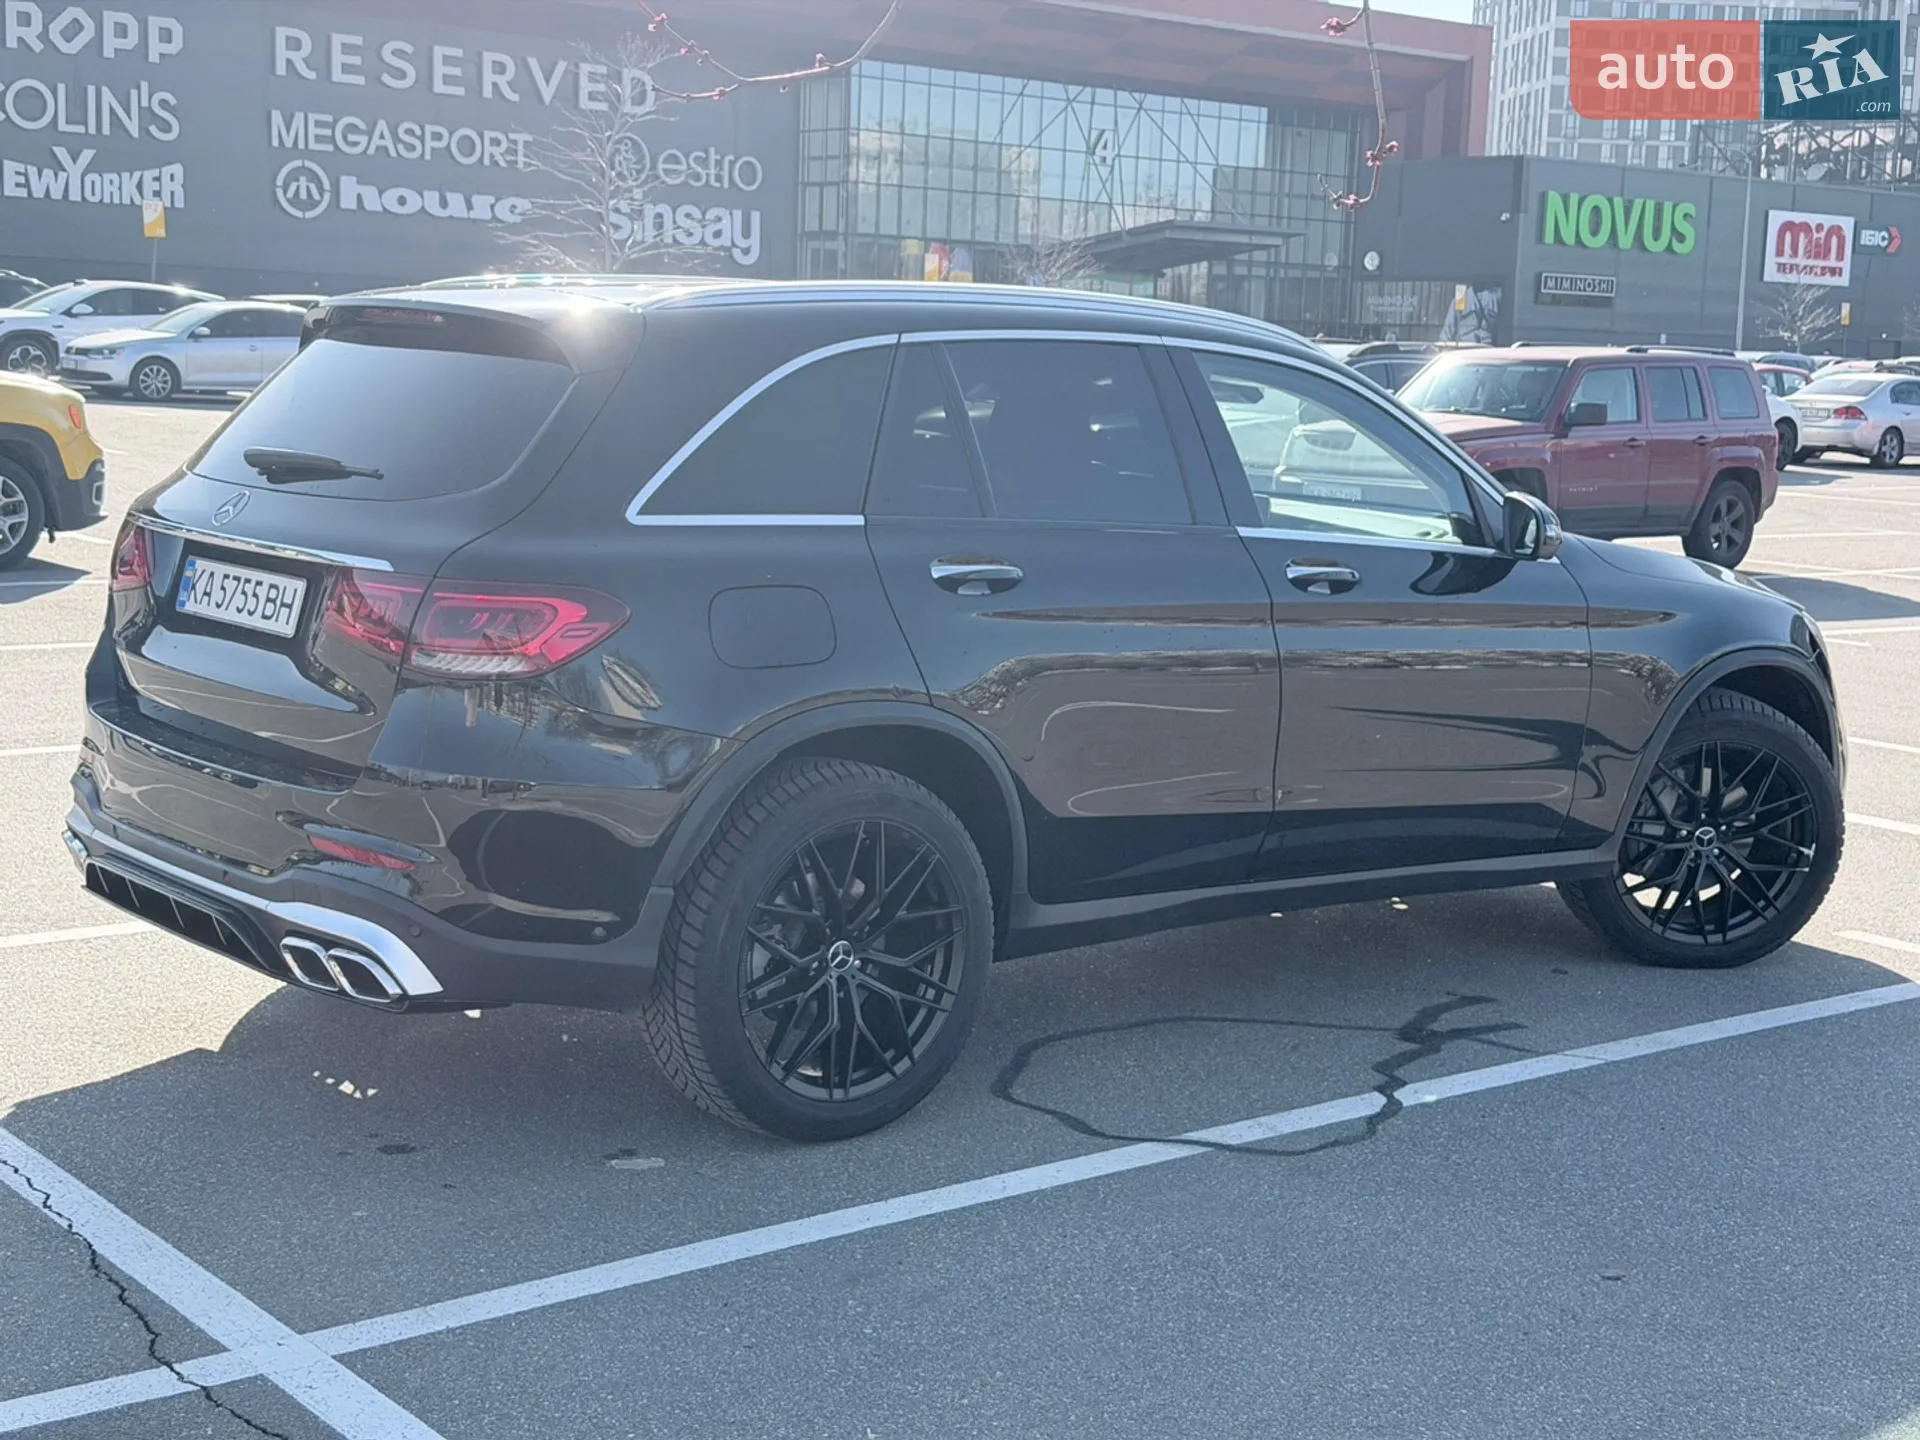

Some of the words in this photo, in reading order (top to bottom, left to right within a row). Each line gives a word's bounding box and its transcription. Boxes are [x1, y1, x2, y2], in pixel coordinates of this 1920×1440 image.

[273, 26, 656, 115] RESERVED
[0, 78, 180, 142] OLIN'S
[270, 109, 533, 169] MEGASPORT
[657, 146, 763, 192] estro
[1094, 130, 1114, 166] 4
[339, 176, 533, 223] house
[609, 189, 762, 266] sinsay
[1543, 190, 1697, 255] NOVUS
[1546, 276, 1612, 293] MIMINOSHI
